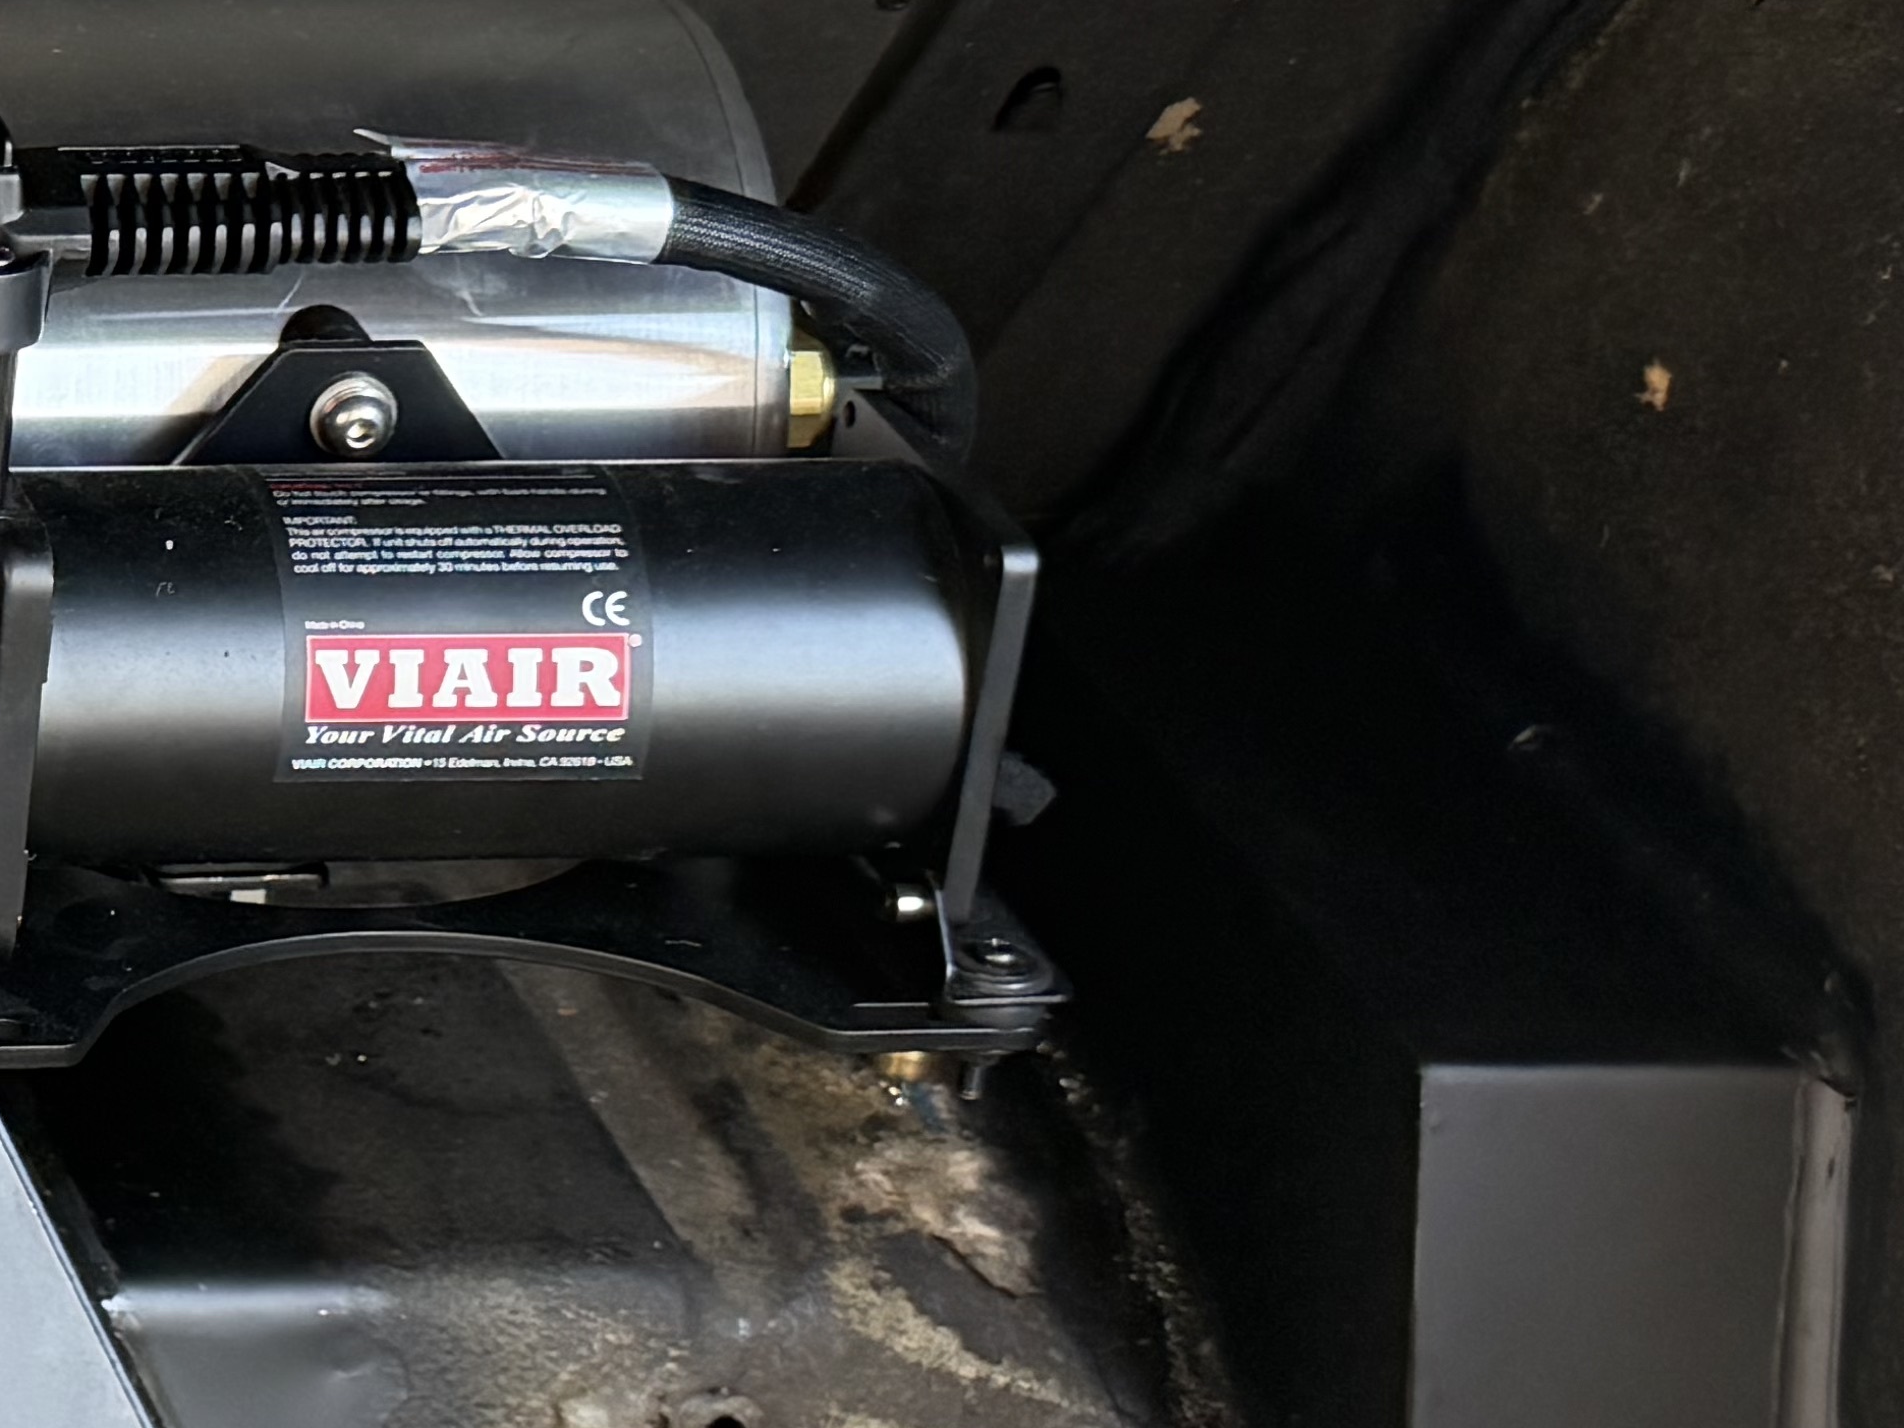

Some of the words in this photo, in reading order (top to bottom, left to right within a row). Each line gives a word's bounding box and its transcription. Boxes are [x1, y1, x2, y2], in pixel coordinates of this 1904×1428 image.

[326, 527, 394, 536] compressor
[404, 526, 458, 536] equipped
[492, 524, 552, 534] THERMAL
[553, 524, 622, 534] OVERLOAD
[288, 538, 369, 548] PROTECTOR.
[437, 537, 453, 546] off
[454, 537, 527, 548] automatically
[530, 538, 567, 547] during
[291, 551, 308, 560] do
[310, 551, 331, 560] not
[334, 550, 379, 561] attempt
[380, 550, 394, 559] to
[396, 550, 434, 559] restart
[509, 549, 541, 558] Allow
[544, 550, 610, 558] compressor
[614, 549, 629, 558] to
[294, 563, 319, 573] cool
[321, 563, 337, 573] off
[338, 563, 355, 573] for
[356, 562, 436, 574] approximately
[437, 562, 454, 572] 30
[454, 562, 500, 572] minutes
[501, 562, 538, 571] before
[582, 591, 630, 626] CE
[314, 647, 621, 710] VIAIR
[305, 725, 375, 746] Your
[381, 724, 454, 744] Vital
[458, 724, 512, 743] Air
[516, 723, 626, 743] Source
[291, 758, 326, 769] VIAIR
[327, 757, 422, 769] CORPORATION
[539, 757, 558, 767] CA
[604, 756, 634, 767] USA
